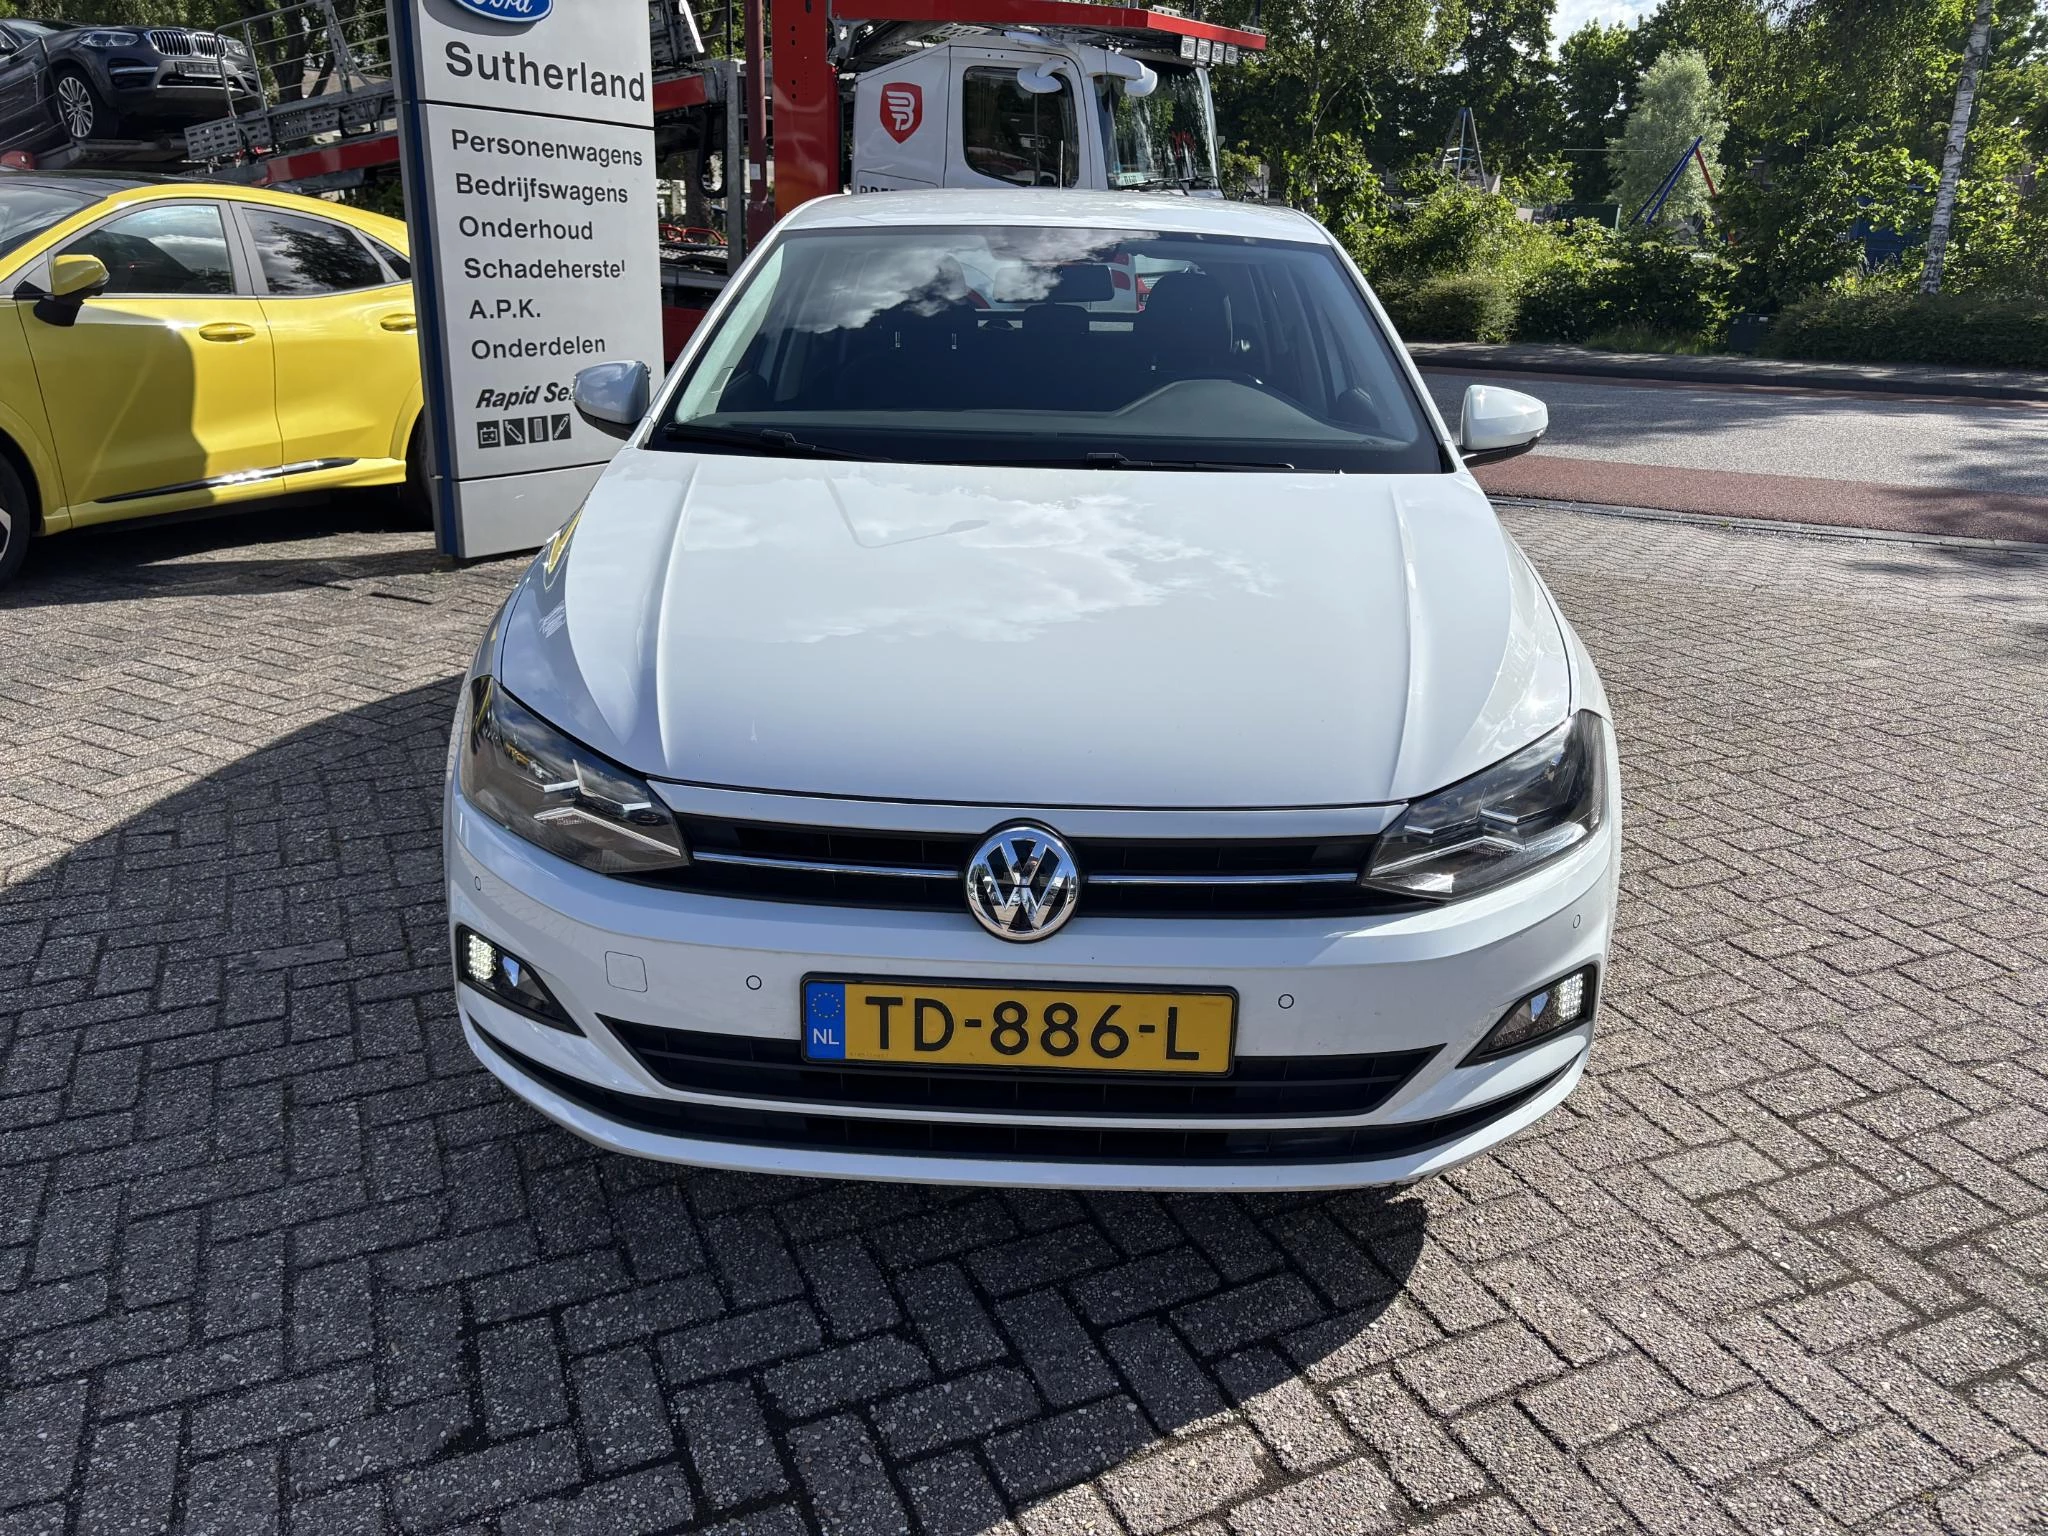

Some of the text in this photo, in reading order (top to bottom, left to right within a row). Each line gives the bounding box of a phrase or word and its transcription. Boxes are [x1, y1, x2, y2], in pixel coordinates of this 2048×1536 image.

[445, 41, 645, 102] Sutherland
[451, 129, 643, 168] Personenwagens
[456, 173, 628, 205] Bedrijfswagens
[459, 216, 593, 240] Onderhoud
[469, 299, 541, 319] A.P.K.
[471, 336, 606, 359] Onderdelen
[476, 382, 575, 411] Rapid Se
[813, 996, 1200, 1060] NL TD-886-L
